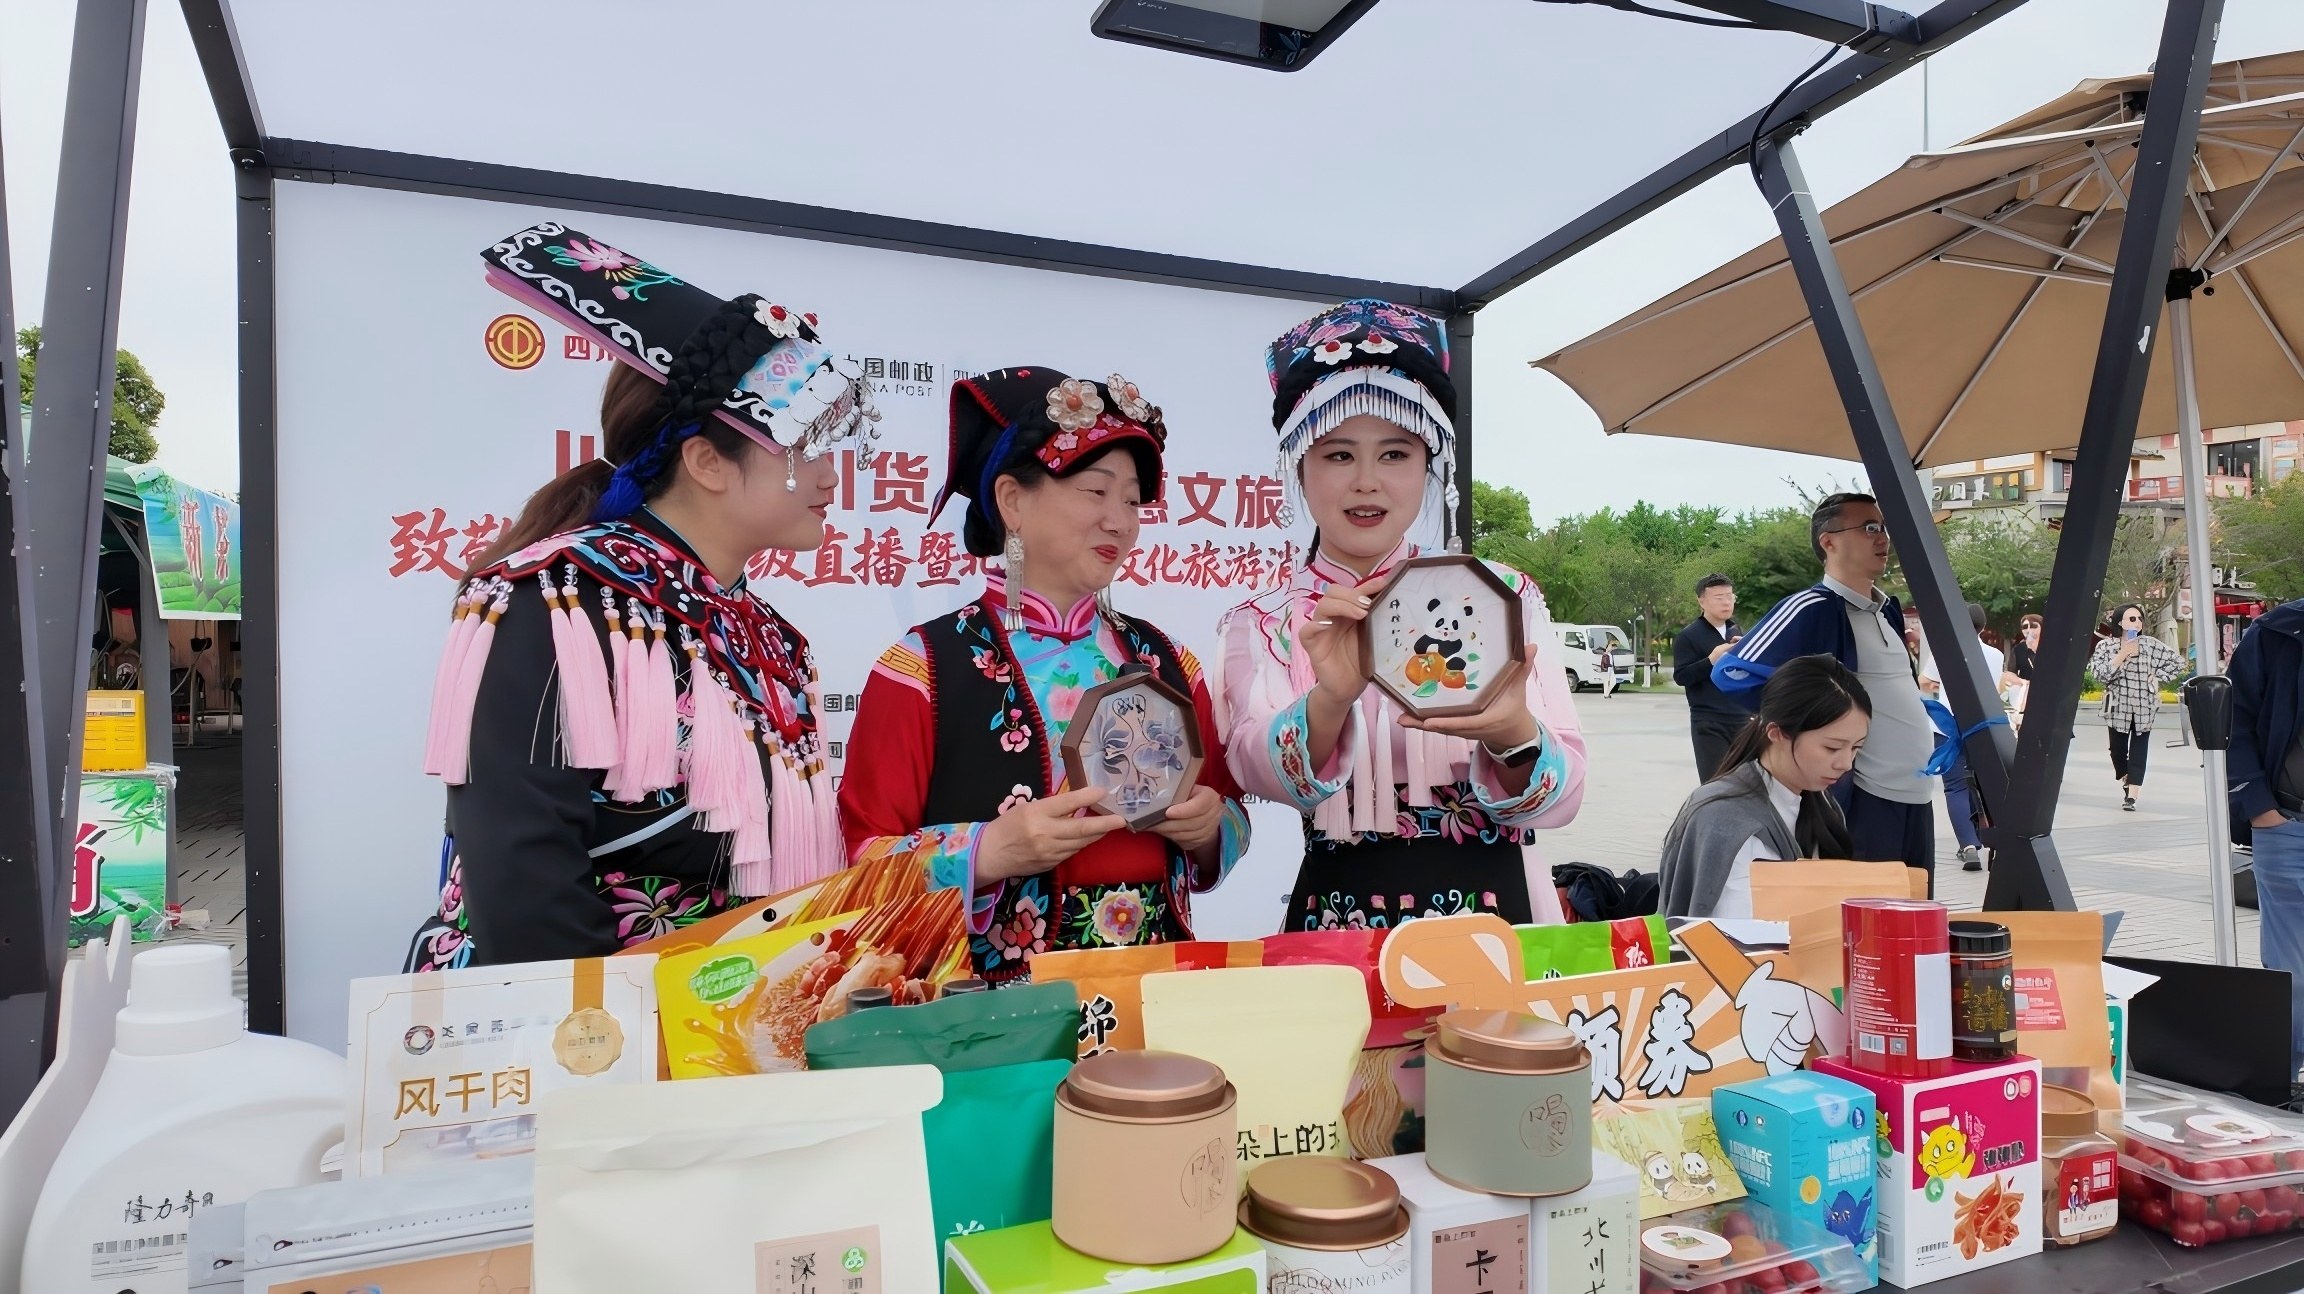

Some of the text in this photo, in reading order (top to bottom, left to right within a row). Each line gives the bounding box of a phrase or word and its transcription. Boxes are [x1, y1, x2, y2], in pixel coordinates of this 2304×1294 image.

[845, 354, 934, 384] 国邮政
[1077, 993, 1118, 1059] 绵
[394, 1065, 532, 1120] 风干肉
[1465, 1249, 1499, 1294] 卡
